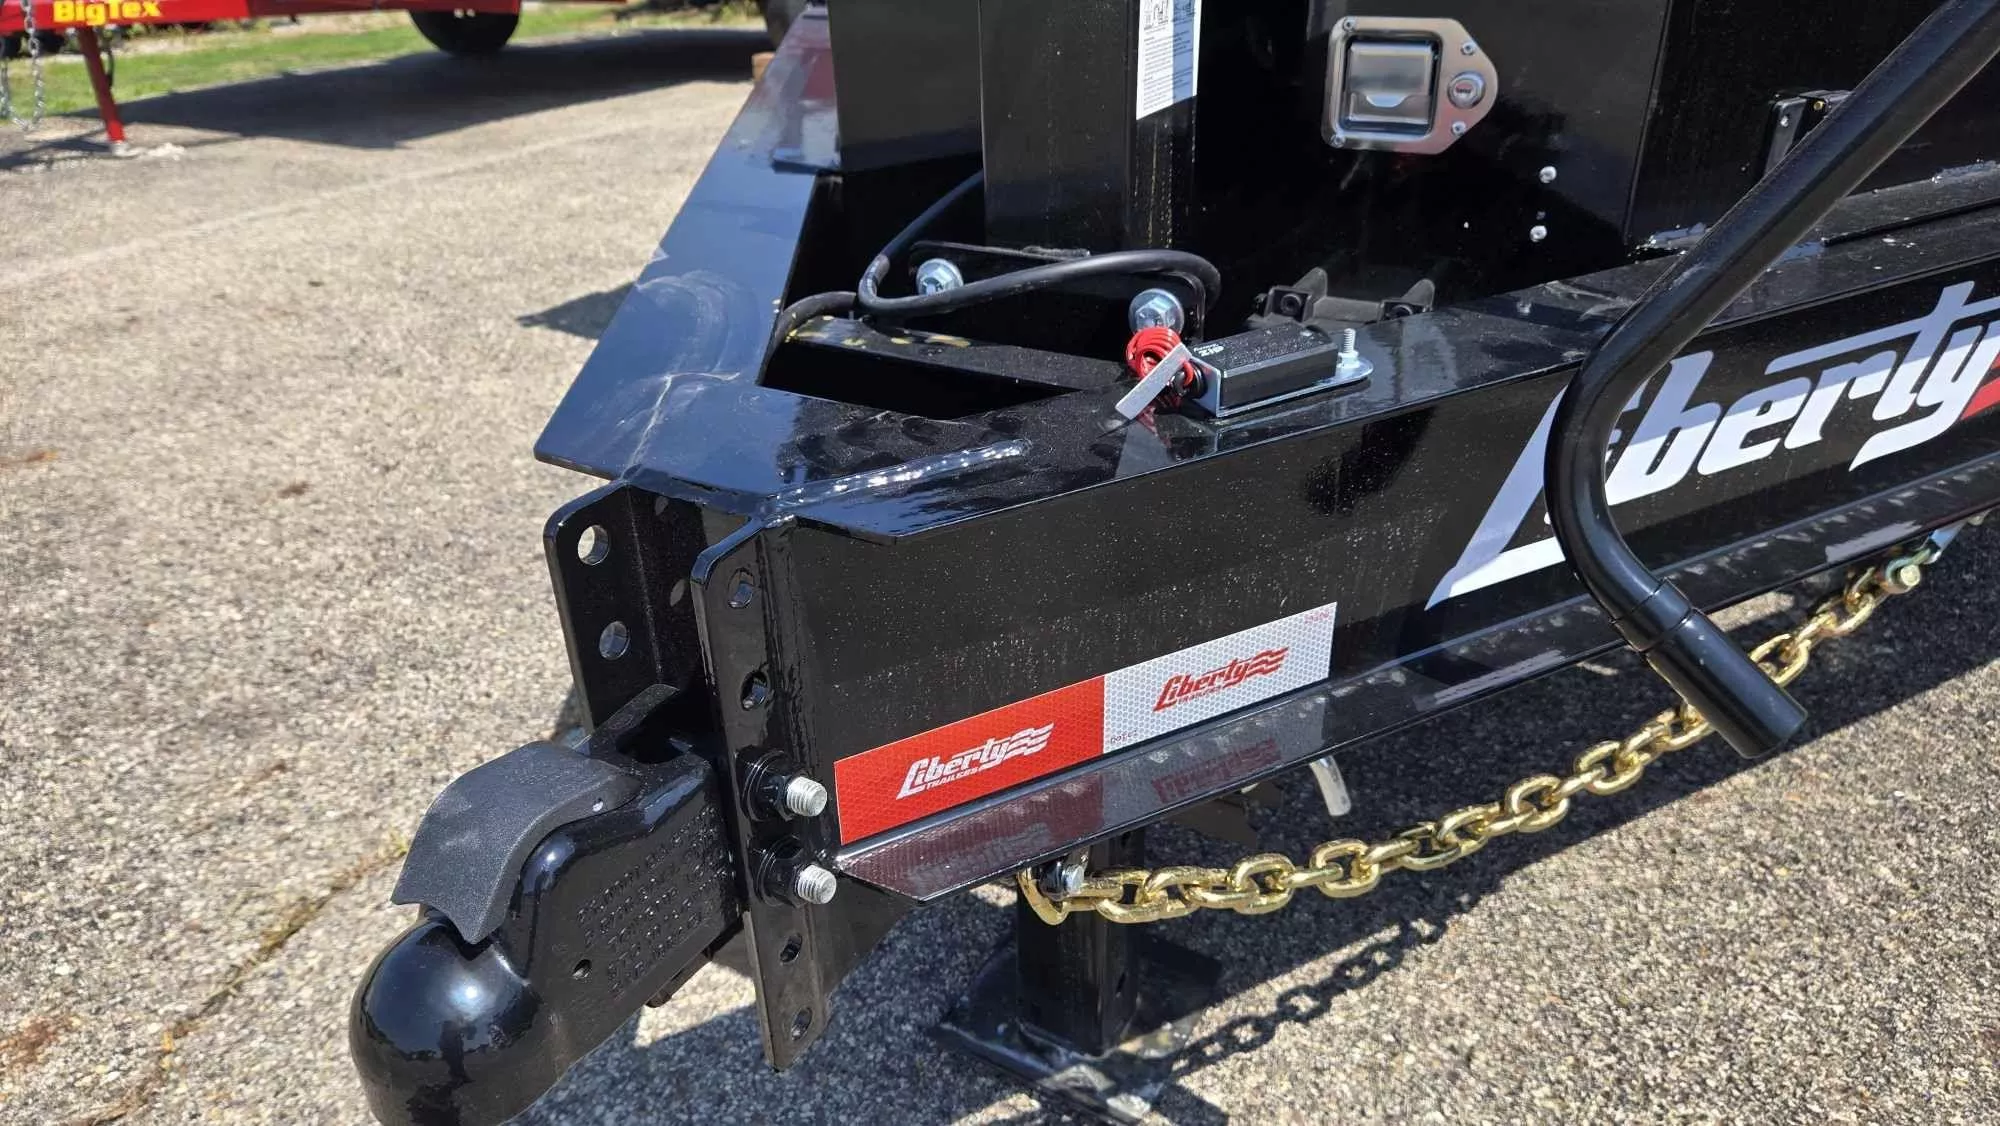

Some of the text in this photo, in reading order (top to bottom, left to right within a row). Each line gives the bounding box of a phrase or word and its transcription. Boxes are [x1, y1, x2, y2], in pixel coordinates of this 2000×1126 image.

[1153, 658, 1251, 712] Liberty
[896, 737, 1011, 800] Liberty
[926, 767, 979, 790] TRAILERS
